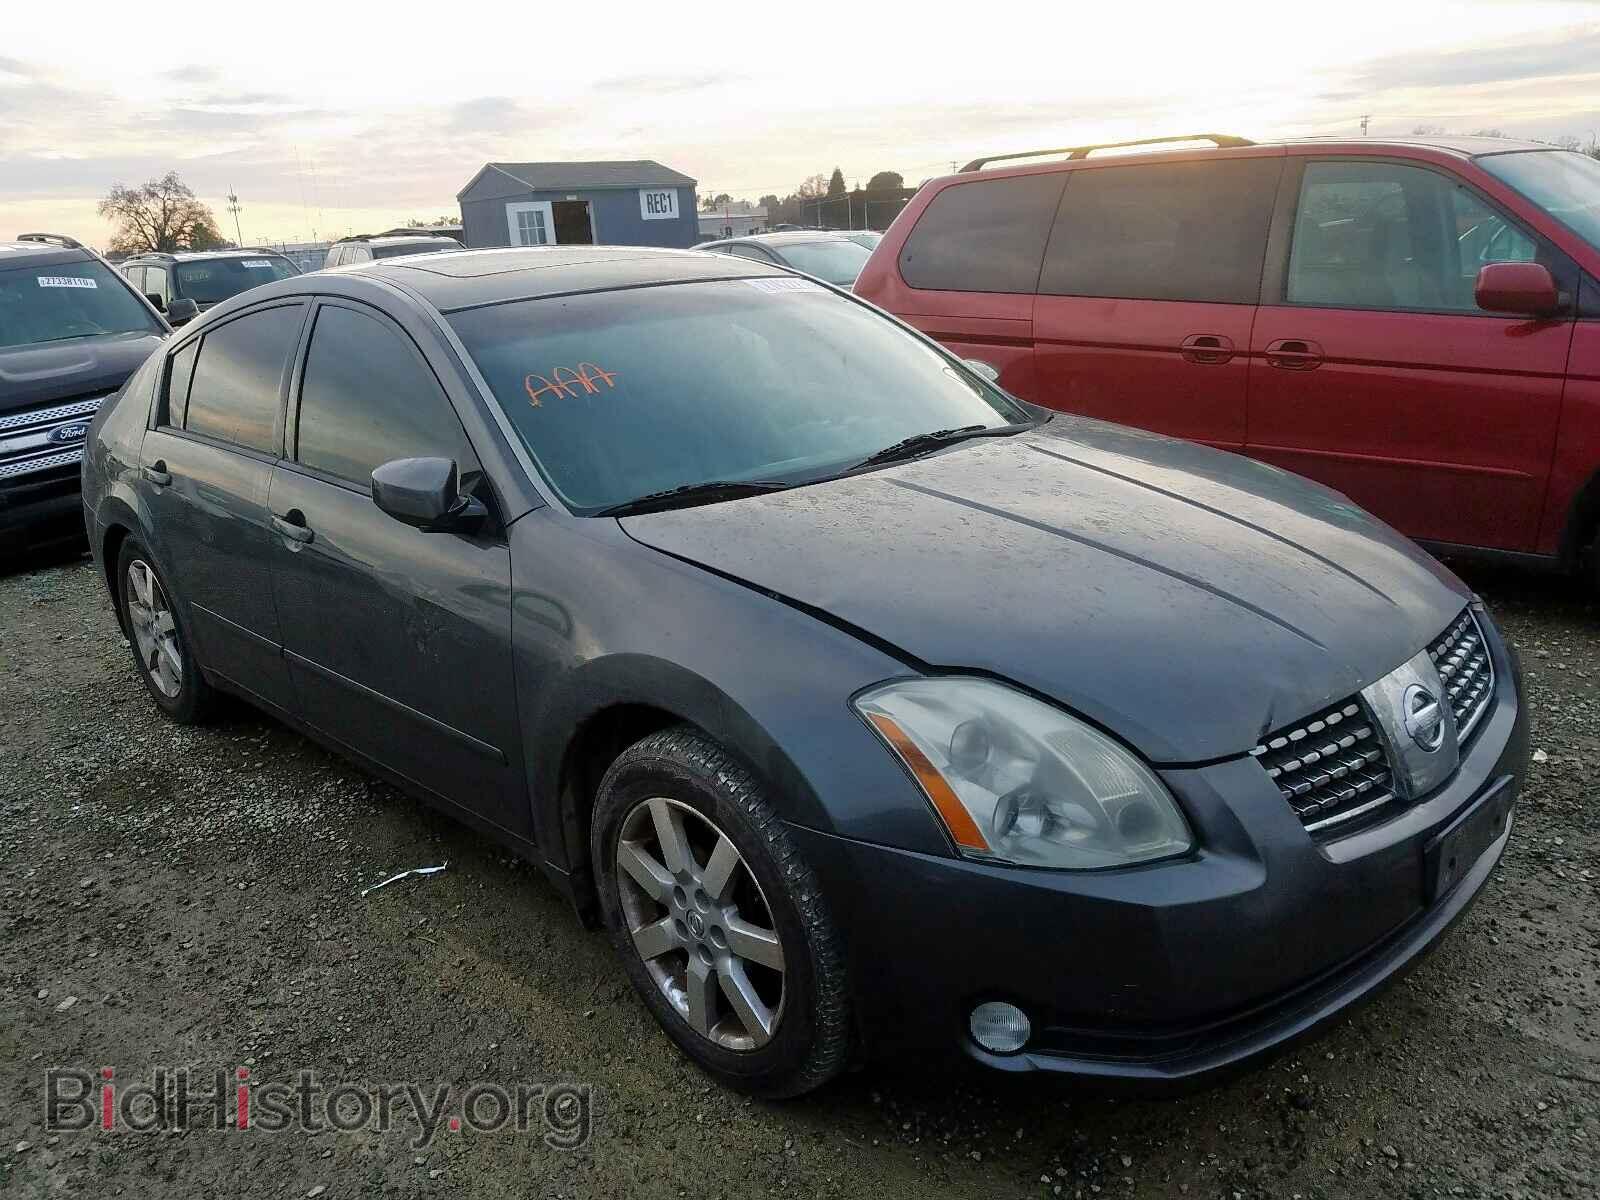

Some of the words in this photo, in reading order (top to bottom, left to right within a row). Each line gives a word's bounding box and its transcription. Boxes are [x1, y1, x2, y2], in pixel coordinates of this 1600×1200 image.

[646, 192, 673, 214] REC1
[524, 361, 617, 408] AAA
[60, 426, 86, 440] Ford
